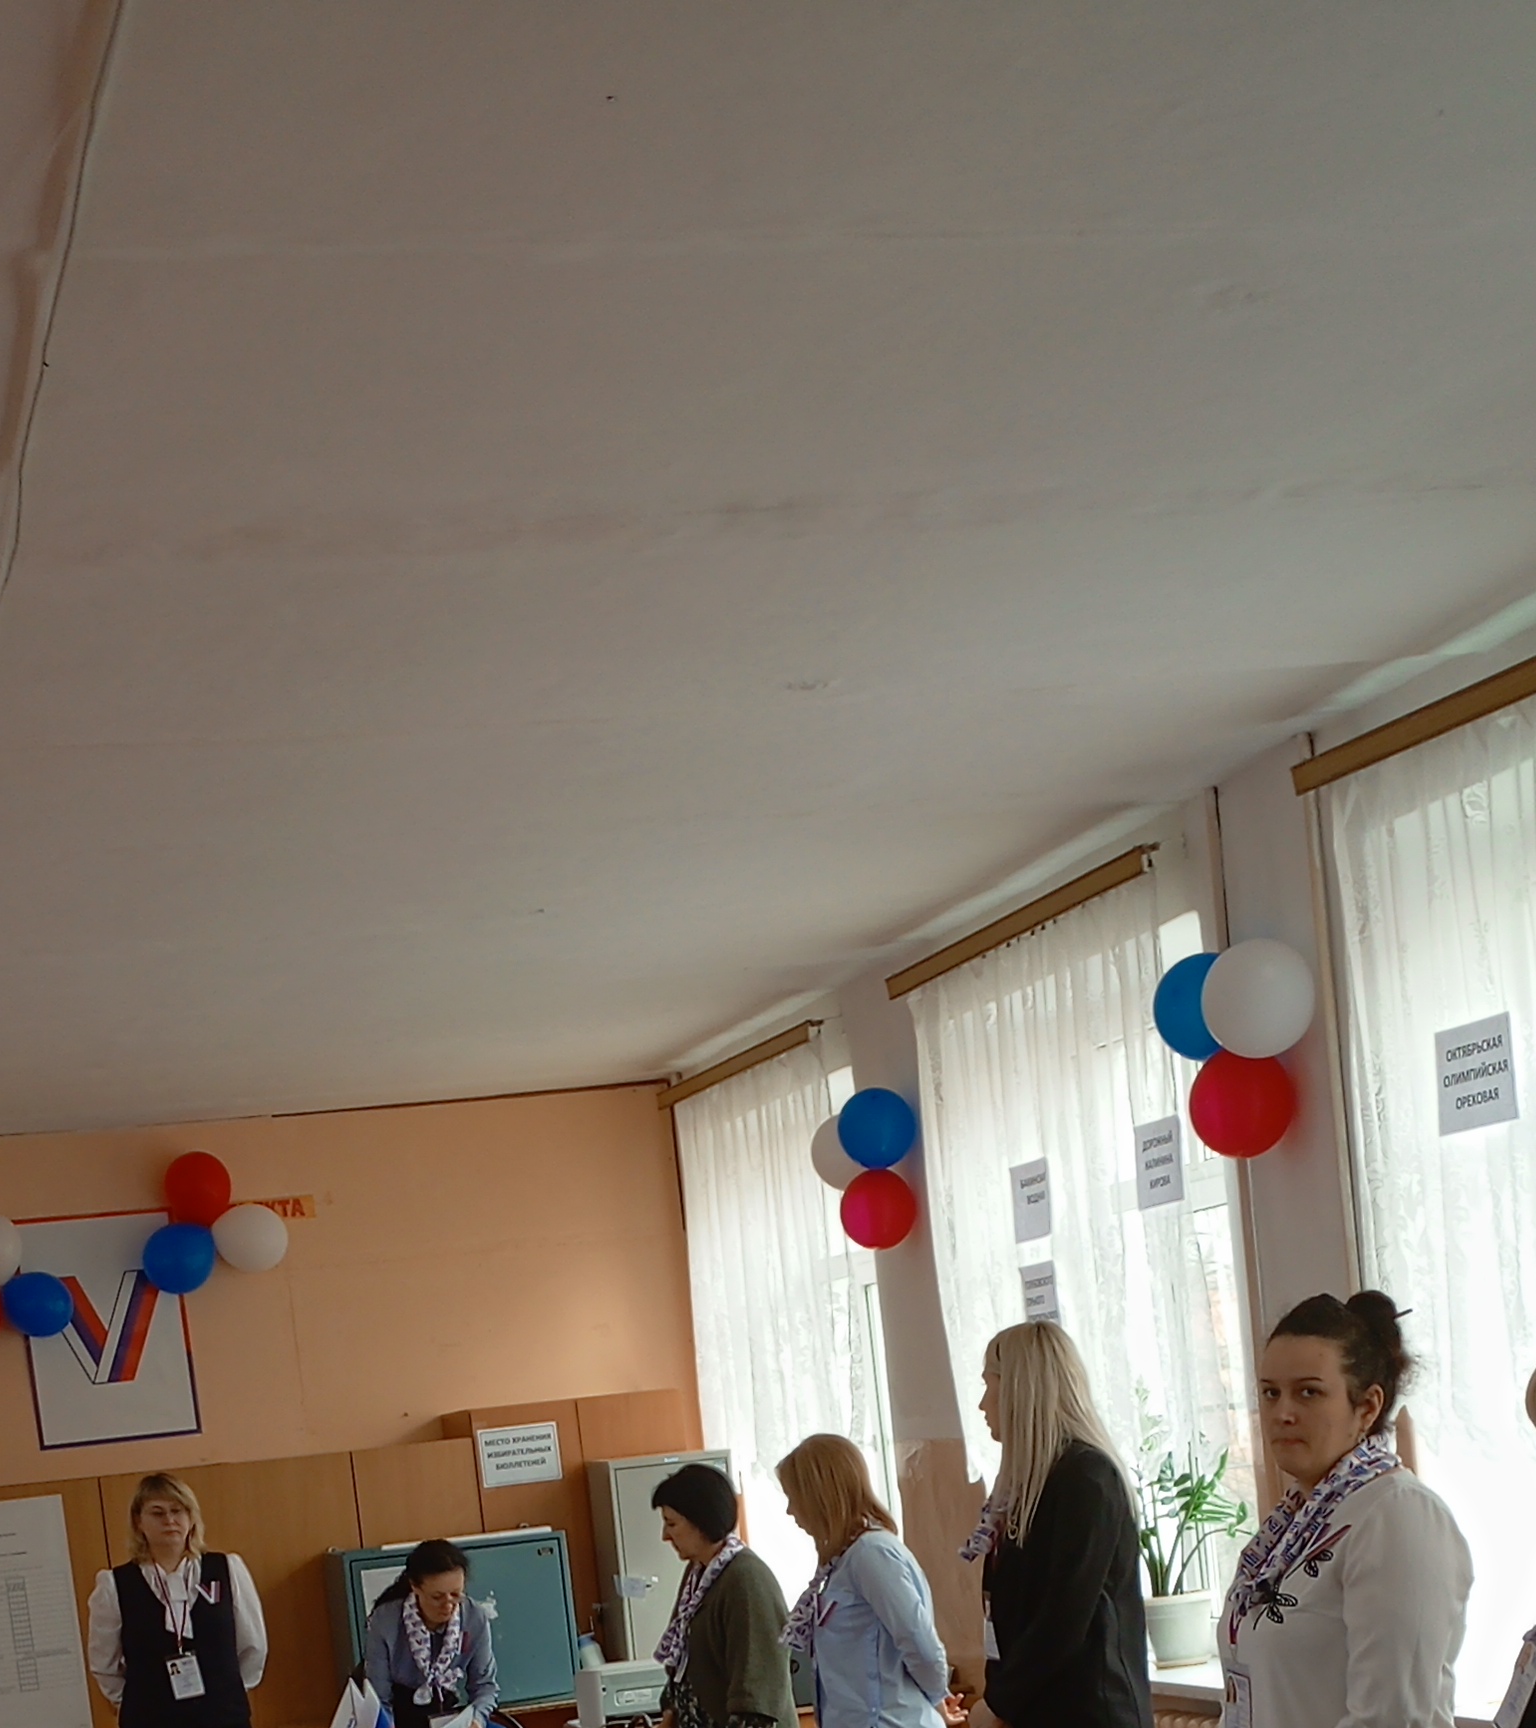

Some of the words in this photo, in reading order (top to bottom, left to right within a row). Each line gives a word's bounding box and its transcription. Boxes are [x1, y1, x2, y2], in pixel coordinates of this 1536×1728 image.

[1445, 1034, 1503, 1062] ОКТЯБРЬСКАЯ
[1443, 1059, 1509, 1088] ОЛИМПИЙСКАЯ
[1455, 1087, 1500, 1110] ОРЕХОВАЯ
[484, 1437, 511, 1447] МЕСТО
[512, 1433, 551, 1444] ХРАНЕНИЯ
[487, 1445, 552, 1459] ИЗБИРАТЕЛЬНЫХ
[496, 1457, 547, 1470] БЮЛЛЕТЕНЕЙ
